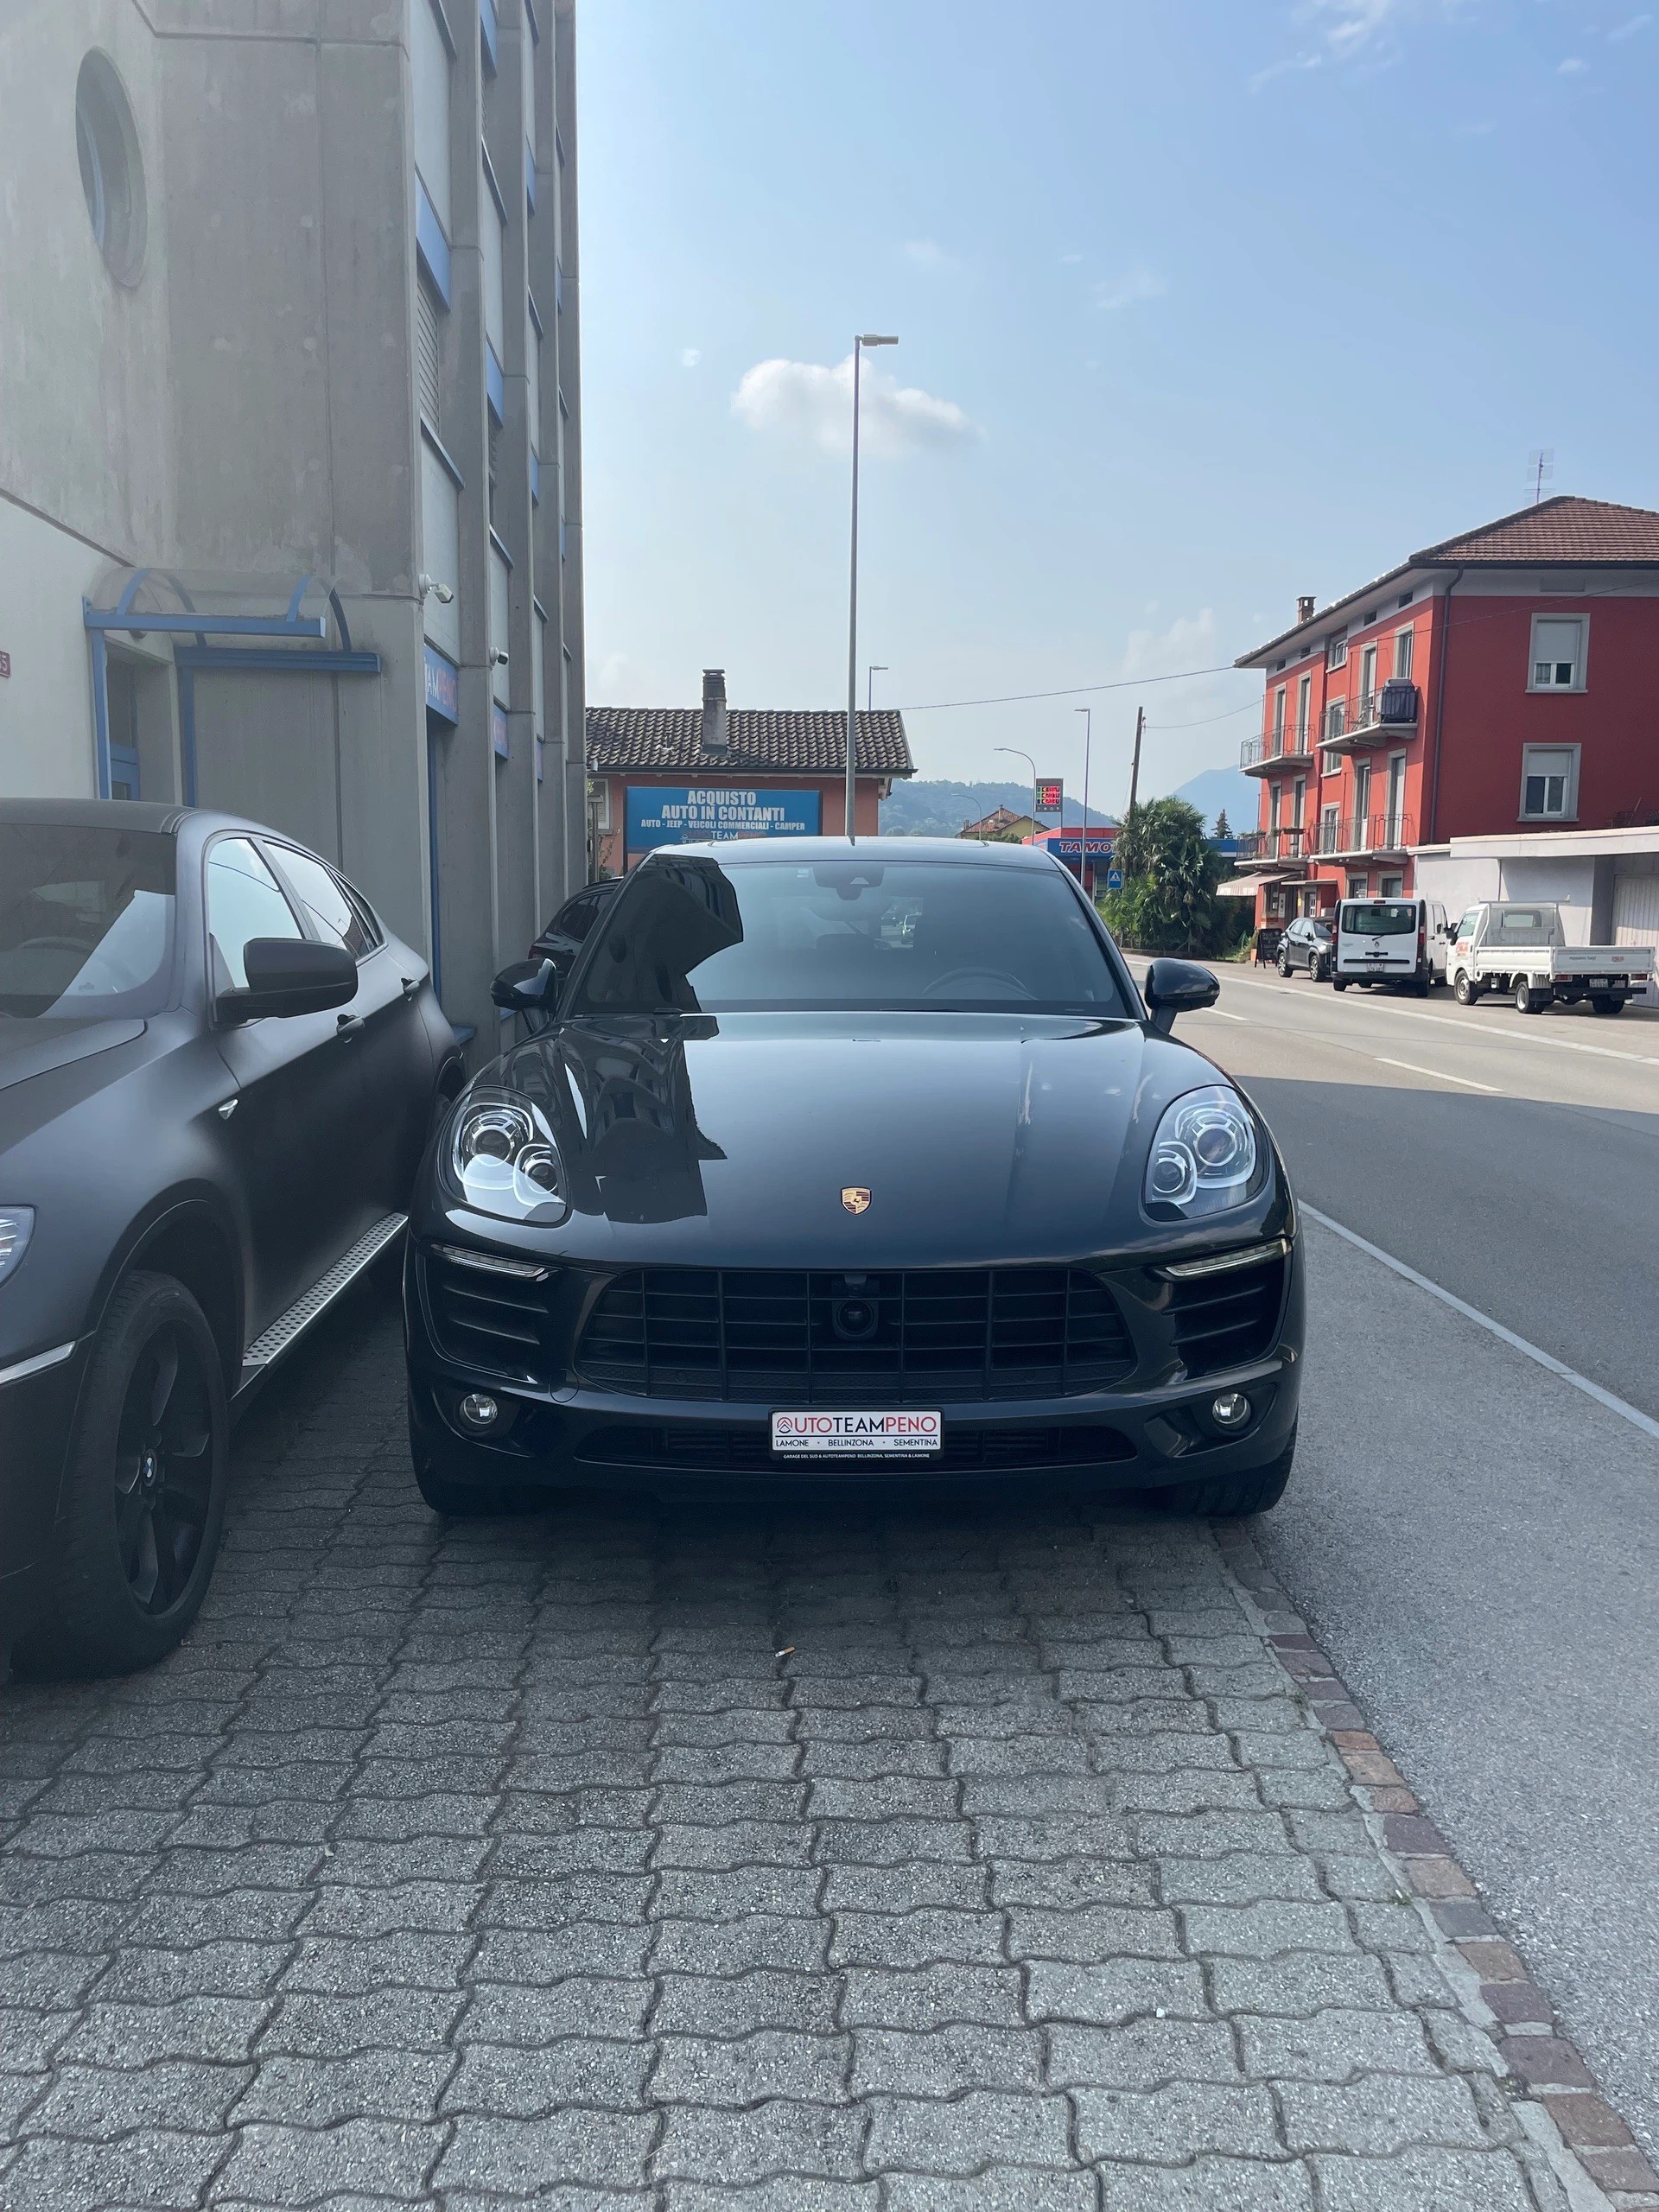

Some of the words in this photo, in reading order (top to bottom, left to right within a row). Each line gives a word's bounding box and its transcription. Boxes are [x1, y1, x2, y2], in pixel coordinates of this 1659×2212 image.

[687, 791, 756, 806] ACQUISTO
[661, 805, 697, 819] AUTO
[701, 806, 715, 820] IN
[718, 806, 785, 821] CONTANTI
[641, 819, 661, 828] AUTO
[718, 821, 769, 830] COMMERCIALI
[775, 822, 805, 830] CAMPER
[1059, 841, 1116, 854] TAMO
